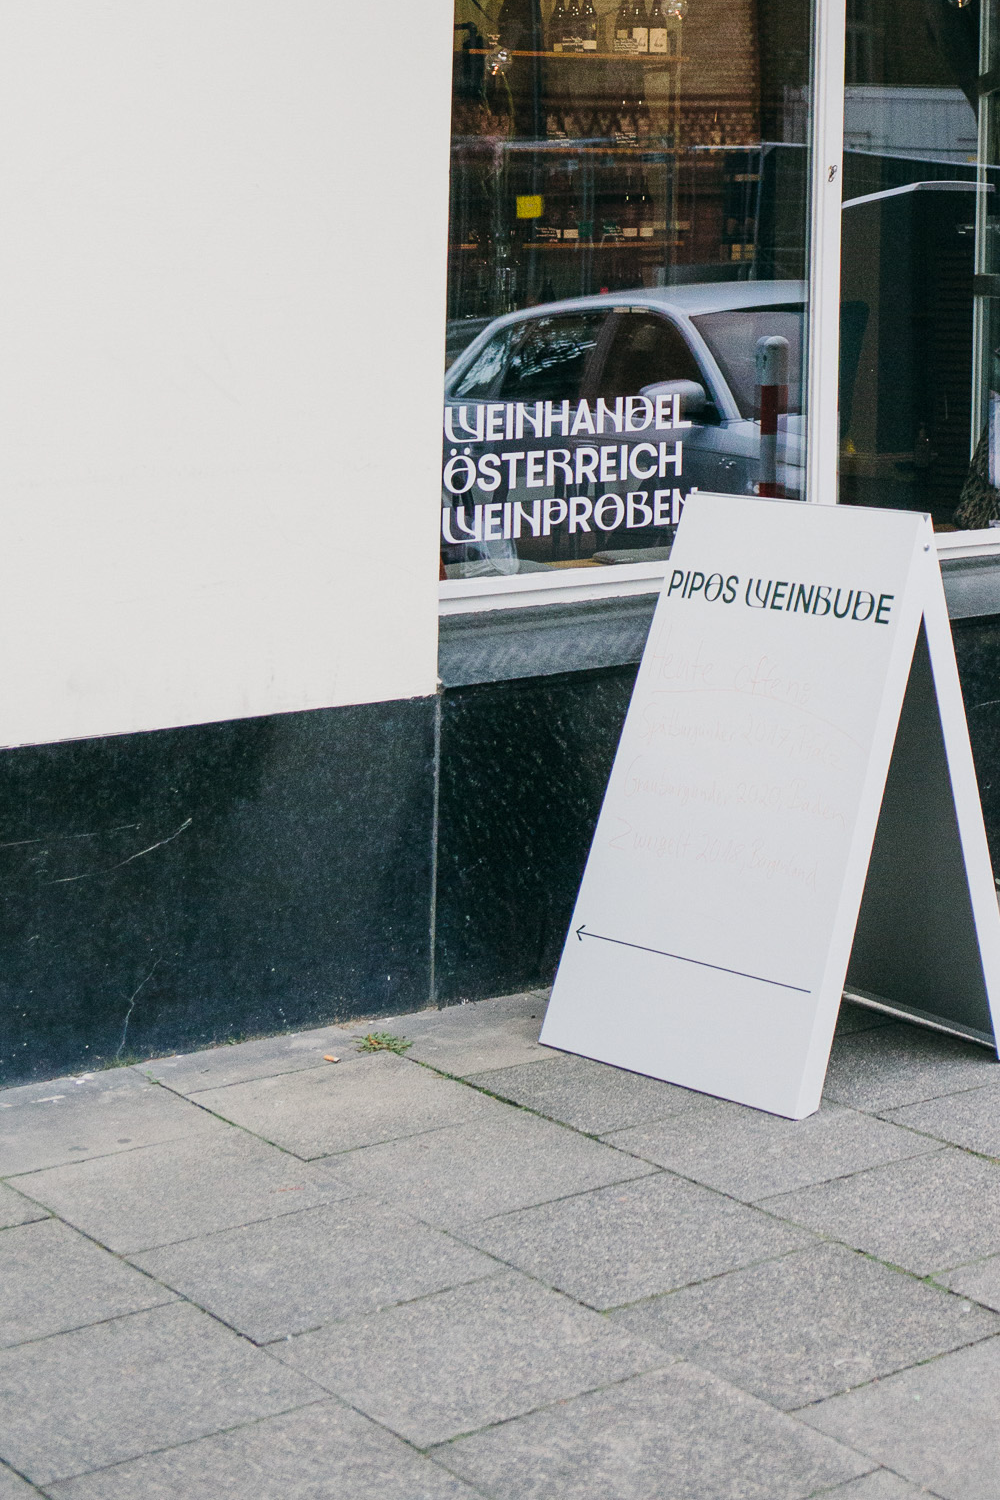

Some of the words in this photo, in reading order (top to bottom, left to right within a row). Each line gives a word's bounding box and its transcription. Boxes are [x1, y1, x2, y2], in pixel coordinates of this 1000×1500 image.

[443, 393, 692, 443] WEINHANDEL
[443, 441, 683, 494] ÖSTERREICH
[667, 569, 739, 603] PIPOS
[745, 577, 895, 625] WEINBUDE
